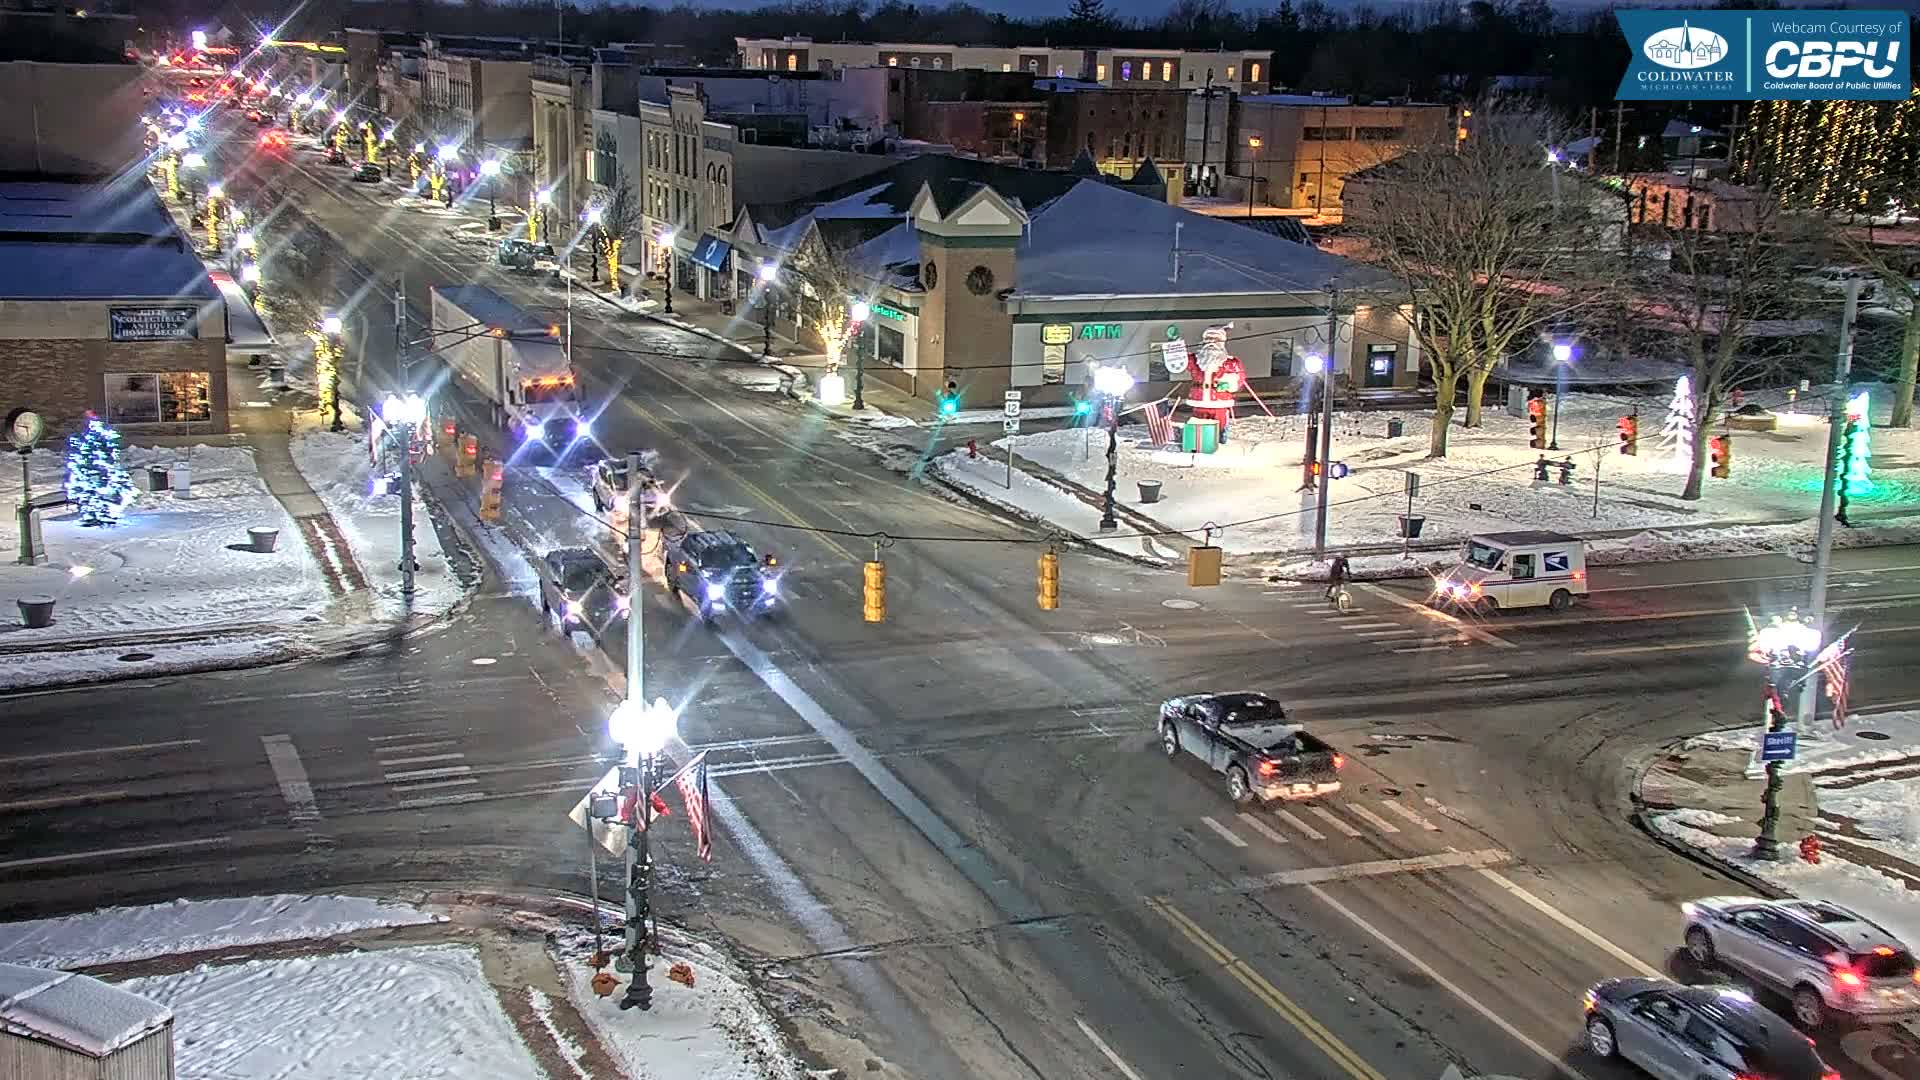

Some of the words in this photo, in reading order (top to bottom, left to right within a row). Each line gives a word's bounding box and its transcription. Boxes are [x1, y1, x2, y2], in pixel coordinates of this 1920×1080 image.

[132, 322, 178, 330] ANTIQUES
[122, 329, 151, 337] HOME
[154, 329, 186, 337] DECOR
[1079, 324, 1121, 340] ATM
[1007, 403, 1018, 413] 12
